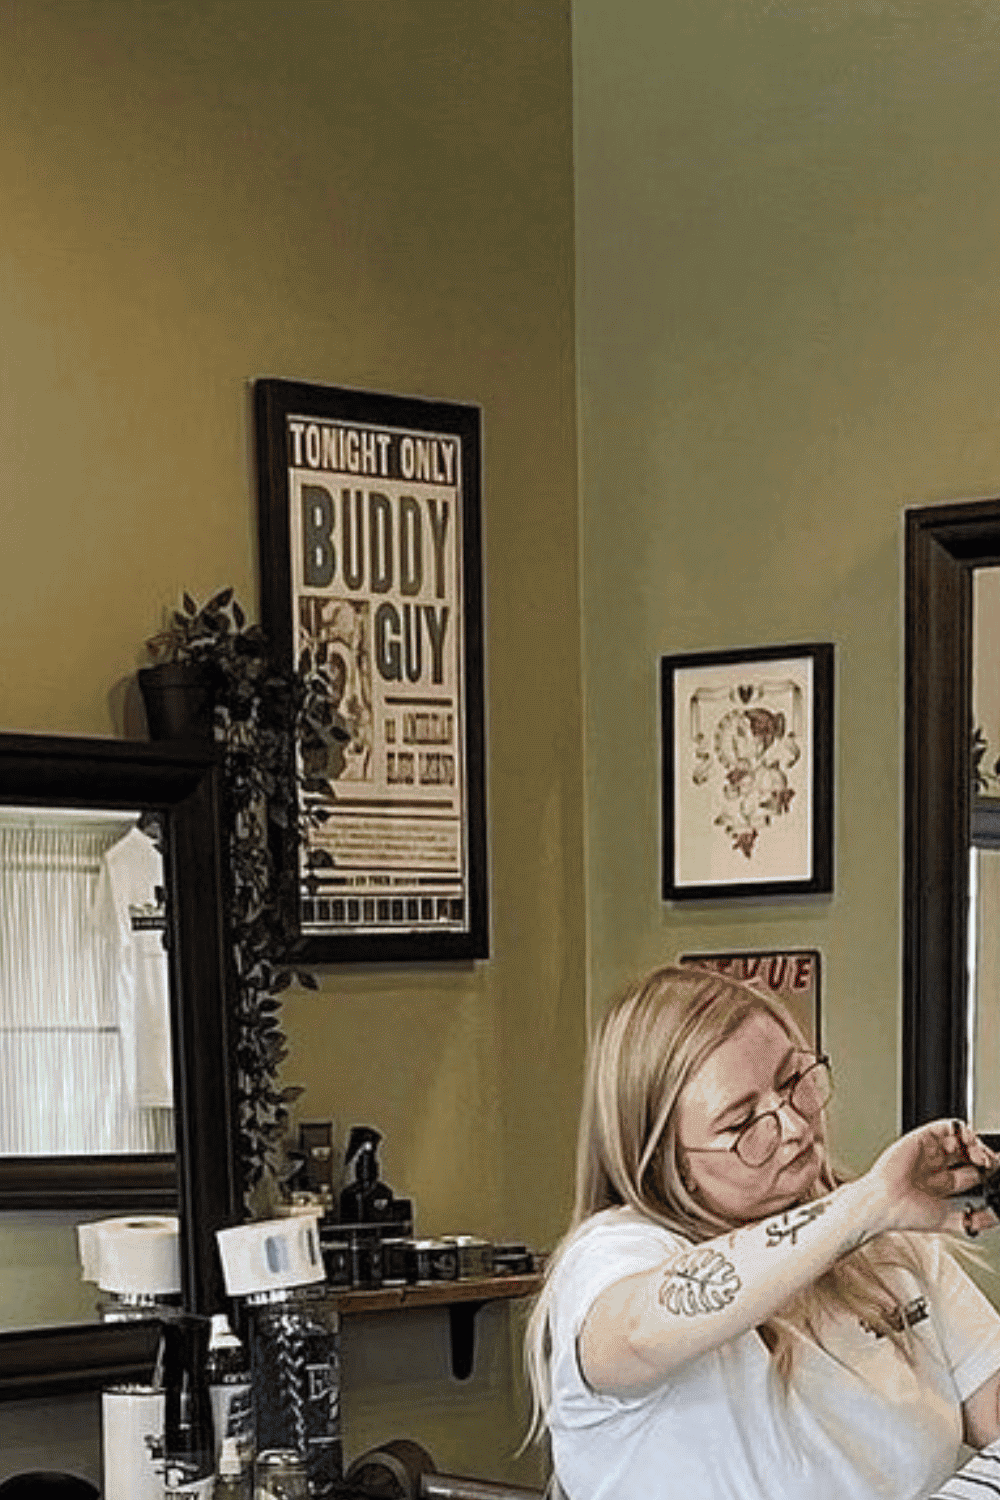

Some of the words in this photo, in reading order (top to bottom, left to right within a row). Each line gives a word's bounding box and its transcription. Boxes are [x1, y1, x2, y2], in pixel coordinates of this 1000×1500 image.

[289, 423, 391, 476] TONIGHT
[401, 436, 454, 484] ONLY
[300, 483, 449, 599] BUDDY
[374, 601, 449, 685] GUY
